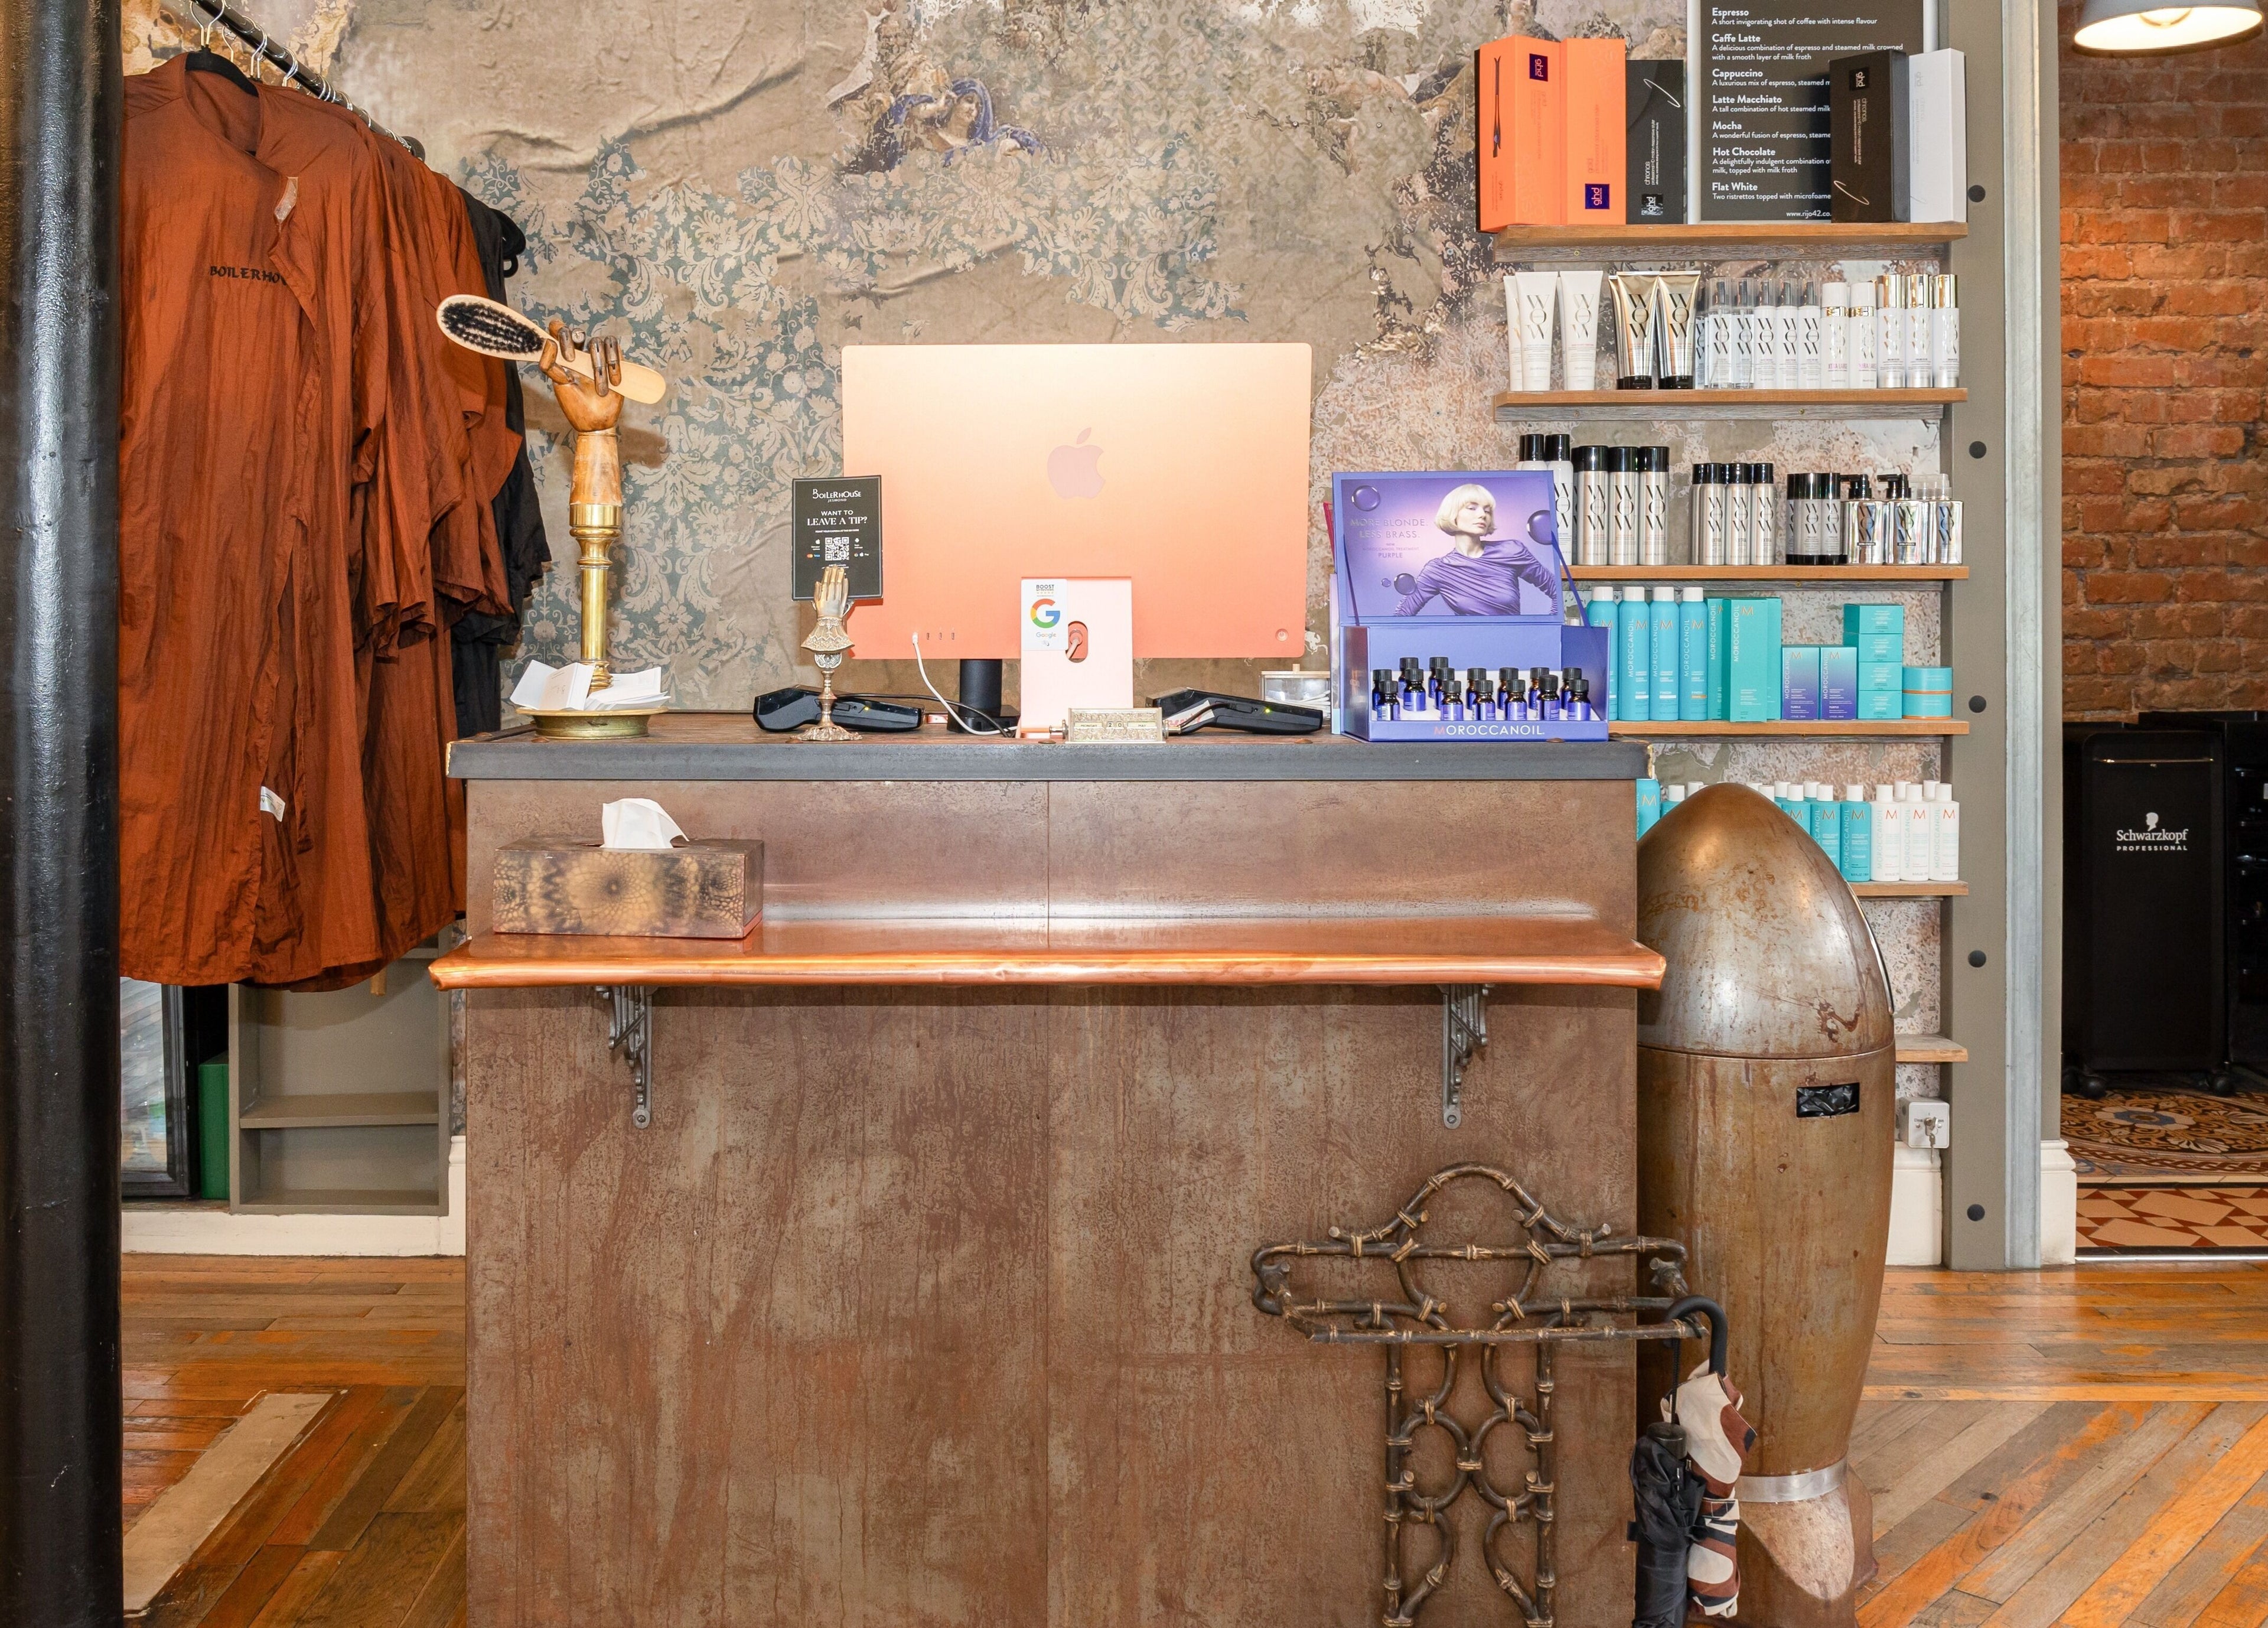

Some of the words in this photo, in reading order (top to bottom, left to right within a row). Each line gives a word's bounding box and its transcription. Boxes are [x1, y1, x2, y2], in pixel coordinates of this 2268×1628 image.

[1712, 7, 1749, 19] Espresso
[1736, 18, 1772, 27] invigorating
[1712, 34, 1736, 42] Caffe
[1739, 34, 1761, 42] Latte
[1757, 54, 1772, 62] layer
[1534, 58, 1543, 77] ghd
[1712, 69, 1763, 80] Cappuccino
[1856, 71, 1865, 87] ghd
[1713, 95, 1735, 103] Latte
[1737, 95, 1782, 103] Macchiato
[1713, 121, 1742, 129] Mocha
[1713, 148, 1729, 156] Hot
[1732, 147, 1775, 155] Chocolate
[1719, 158, 1754, 167] delightfully
[1591, 187, 1602, 206] ghd
[1757, 193, 1778, 201] topped
[1646, 196, 1656, 211] ghd
[210, 266, 286, 285] BOILERHO
[807, 517, 836, 526] LEAVE
[849, 516, 867, 525] TIP?
[1741, 606, 1754, 615] M
[1635, 620, 1647, 630] M
[1660, 620, 1673, 630] M
[1692, 620, 1704, 630] M
[1434, 725, 1543, 735] MOROCCANOIL
[1641, 795, 1657, 806] M
[1822, 810, 1835, 820] M
[1852, 810, 1865, 820] M
[1885, 810, 1897, 819] M
[1914, 809, 1925, 819] M
[1943, 809, 1955, 819] M
[2116, 829, 2189, 844] Schwarzkopf
